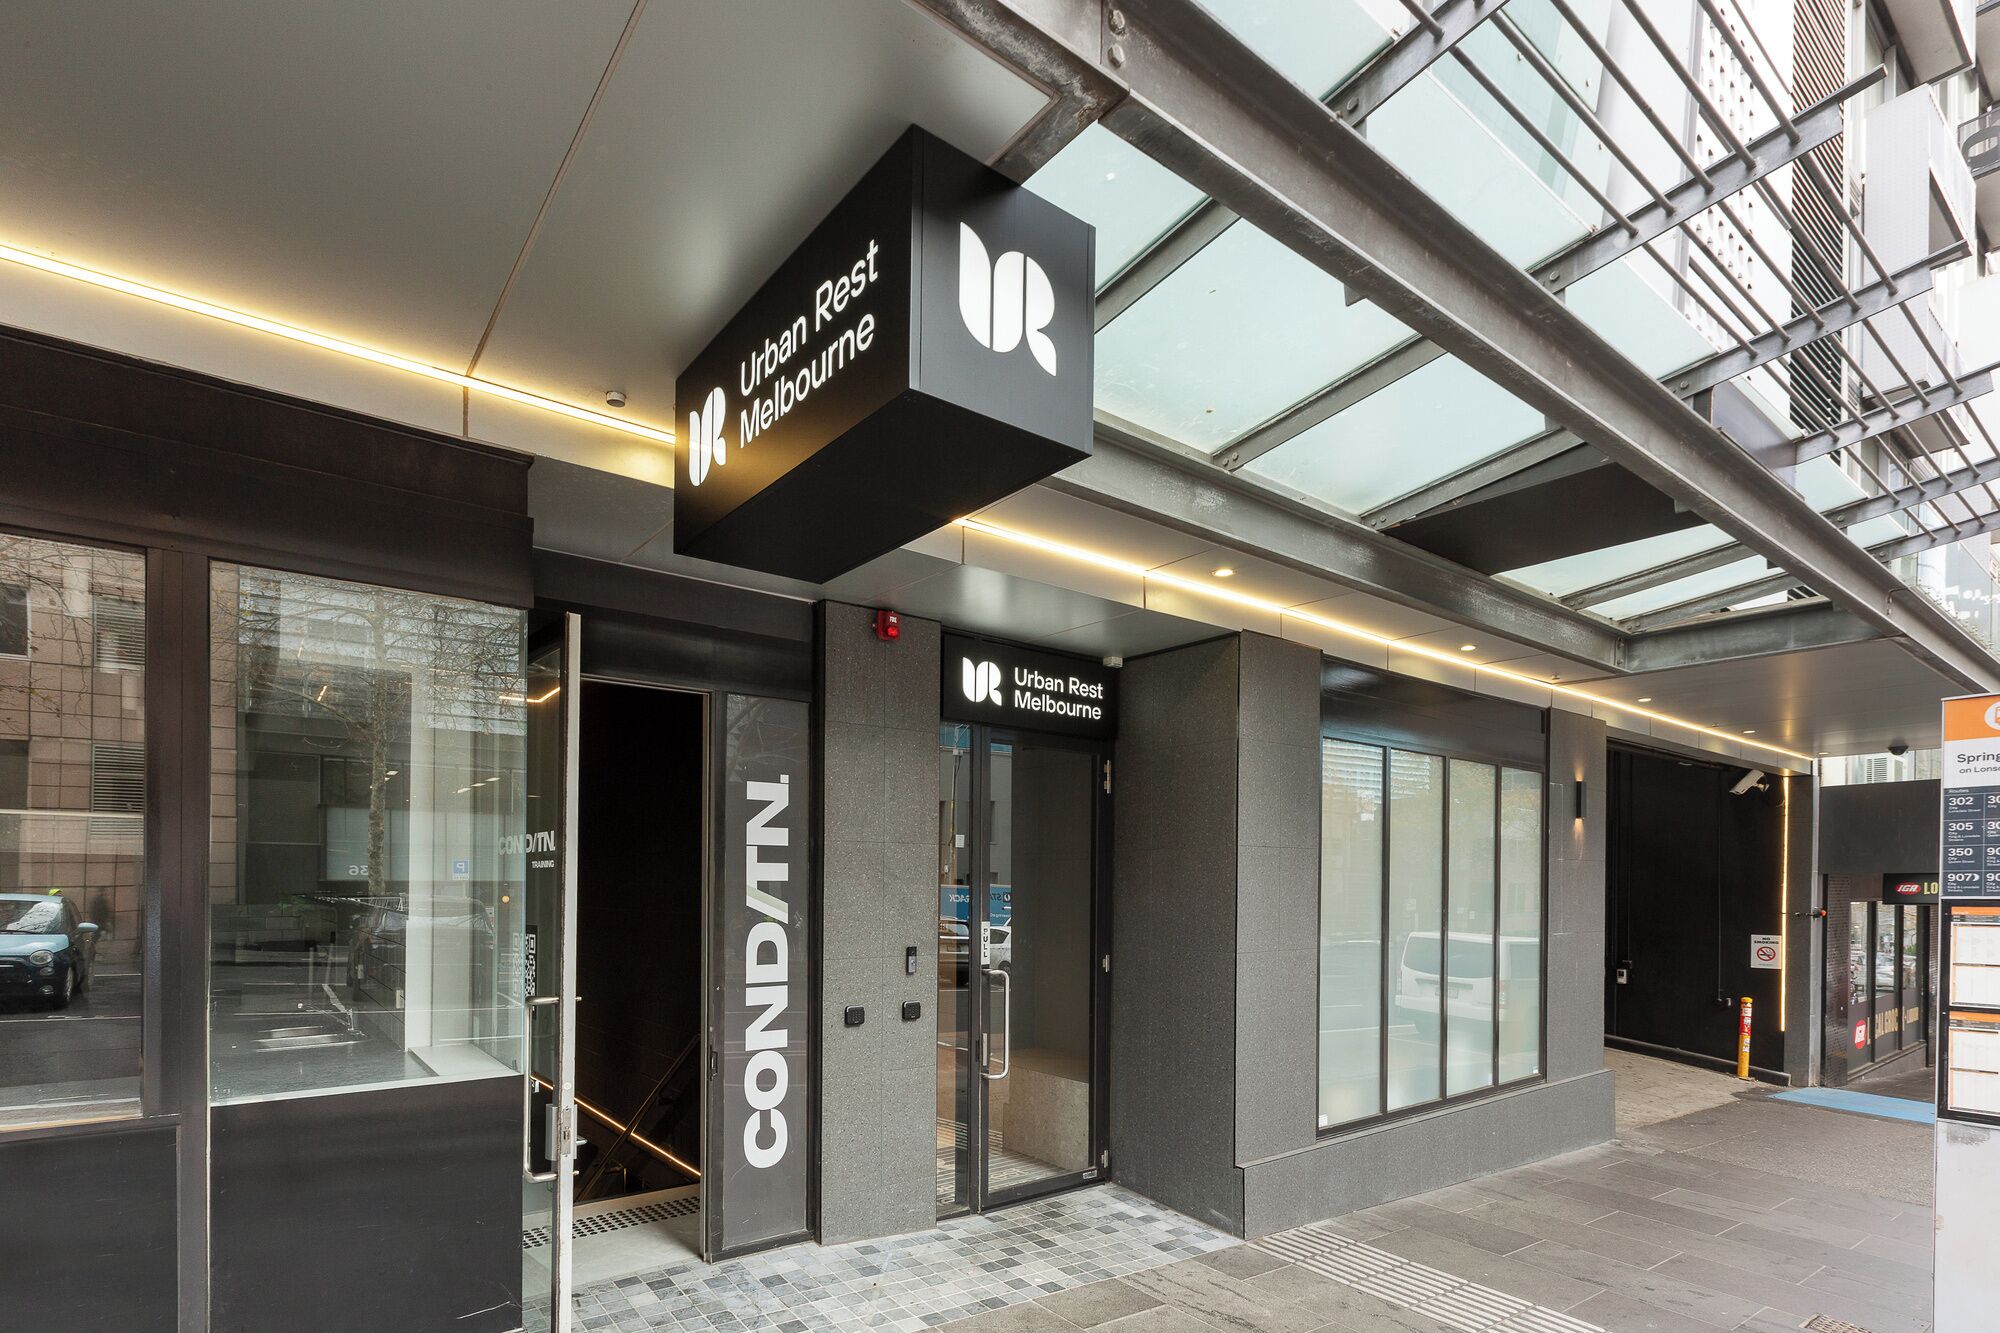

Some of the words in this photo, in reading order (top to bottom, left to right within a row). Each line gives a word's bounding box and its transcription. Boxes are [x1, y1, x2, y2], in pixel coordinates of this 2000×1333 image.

[740, 314, 807, 397] Urban
[815, 238, 879, 332] Rest
[740, 312, 876, 449] Melbourne
[1014, 667, 1064, 693] Urban
[1068, 676, 1103, 699] Rest
[1014, 690, 1102, 720] Melbourne
[1948, 797, 1974, 806] 302
[1948, 822, 1974, 831] 305
[1948, 848, 1973, 857] 350
[531, 860, 555, 869] TRAINING
[1947, 873, 1972, 882] 907
[1897, 884, 1919, 892] IGA
